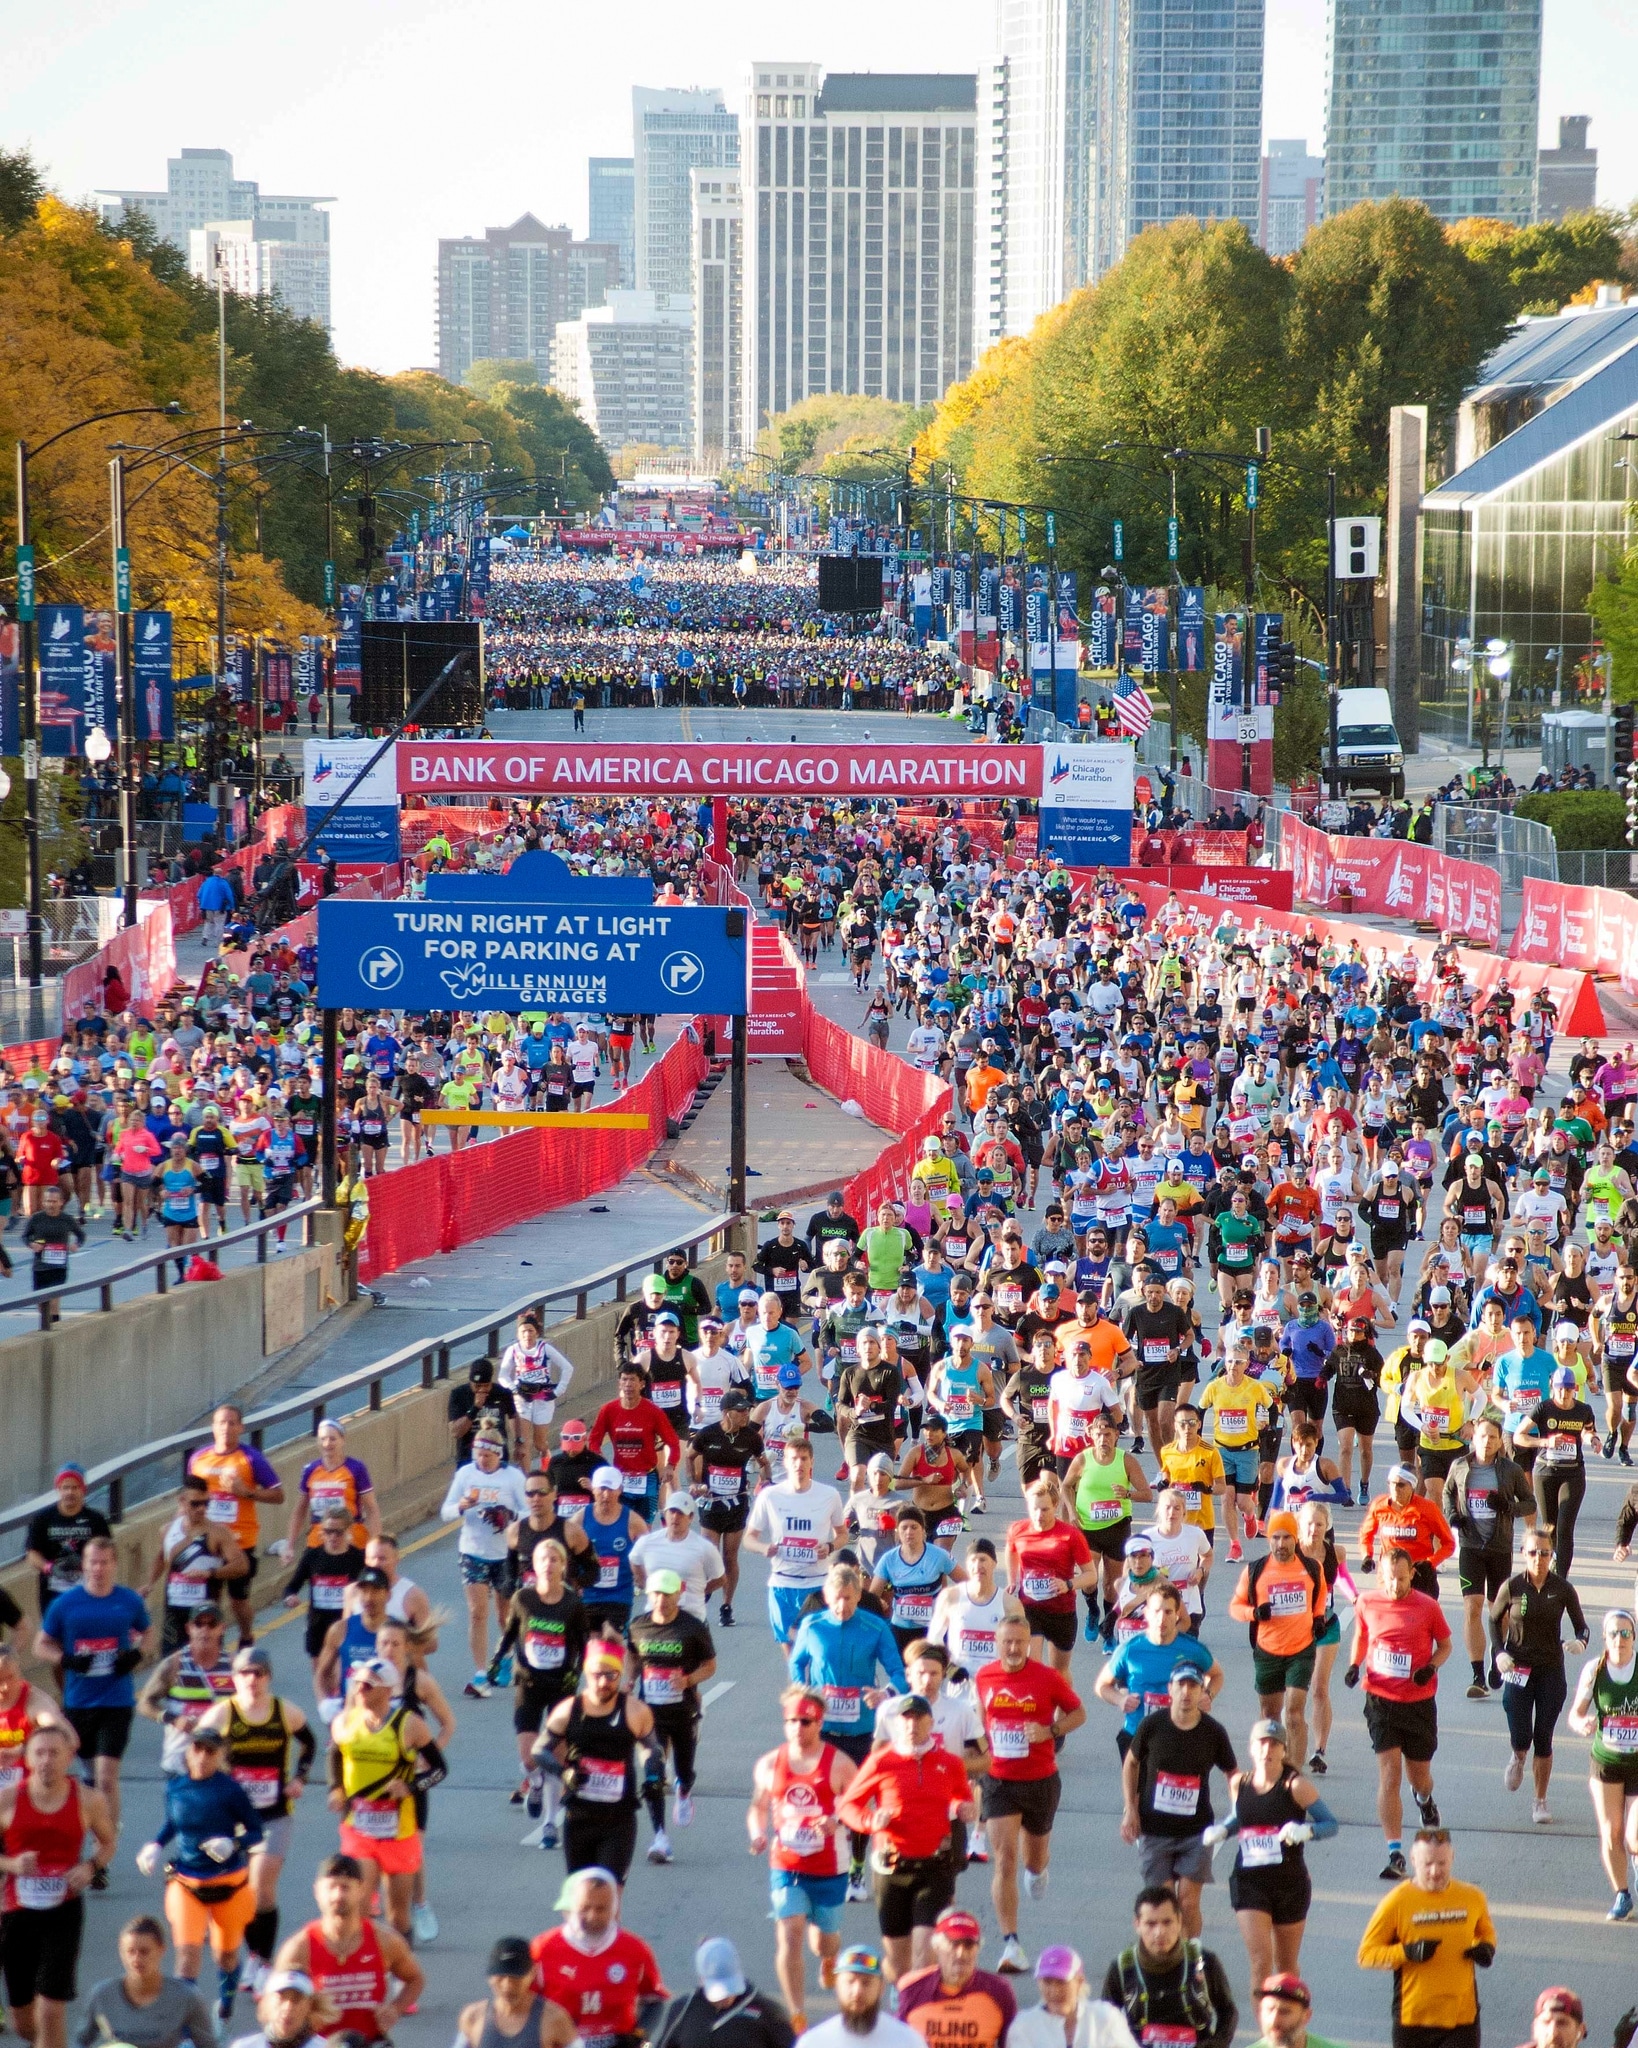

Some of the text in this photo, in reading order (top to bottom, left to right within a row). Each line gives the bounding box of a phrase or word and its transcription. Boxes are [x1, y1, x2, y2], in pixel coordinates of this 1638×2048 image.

[1248, 466, 1257, 504] C110
[580, 532, 618, 541] No re-entry
[639, 532, 677, 541] No re-entry
[698, 533, 737, 544] No re-entry
[1114, 524, 1122, 556] C130
[1169, 522, 1177, 556] C120
[18, 561, 33, 606] C31
[117, 561, 130, 600] C41
[324, 564, 333, 599] C121
[933, 567, 941, 605] CHICAGO
[954, 570, 962, 610] CHICAGO
[979, 574, 988, 616] CHICAGO
[1000, 585, 1009, 631] CHICAGO
[1026, 594, 1036, 643] CHICAGO
[1092, 611, 1102, 665] CHICAGO
[1142, 613, 1153, 672] CHICAGO
[95, 651, 105, 672] LINE
[1214, 641, 1227, 705] CHICAGO
[95, 673, 105, 702] START
[1240, 728, 1257, 739] 30
[411, 757, 1026, 785] BANK OF AMERICA CHICAGO MARATHON
[1072, 765, 1105, 774] Chicago
[1072, 774, 1112, 782] Marathon
[1062, 816, 1077, 824] What
[1079, 816, 1096, 824] would
[1334, 868, 1361, 885] Chicago
[1219, 885, 1251, 894] Chicago
[393, 913, 671, 936] TURN RIGHT AT LIGHT
[425, 939, 641, 962] FOR PARKING AT
[471, 972, 607, 989] MILLENNIUM
[519, 990, 607, 1004] GARAGES
[821, 1228, 847, 1236] CHICAGO
[1152, 1346, 1167, 1354] 13641
[661, 1390, 677, 1398] 4840
[1226, 1417, 1246, 1425] 14666
[1558, 1420, 1584, 1428] LONDON
[718, 1476, 738, 1486] 15558
[1102, 1510, 1119, 1520] 5706
[785, 1517, 812, 1531] Tim
[792, 1548, 814, 1559] 13671
[1279, 1594, 1304, 1604] 14695
[907, 1606, 929, 1617] 13681
[968, 1641, 994, 1652] 15663
[1384, 1651, 1407, 1666] 14901
[832, 1698, 856, 1710] 11753
[999, 1731, 1026, 1744] 14982
[1617, 1729, 1637, 1741] 5212
[1170, 1788, 1194, 1802] 9962
[926, 2020, 978, 2038] BLIND
